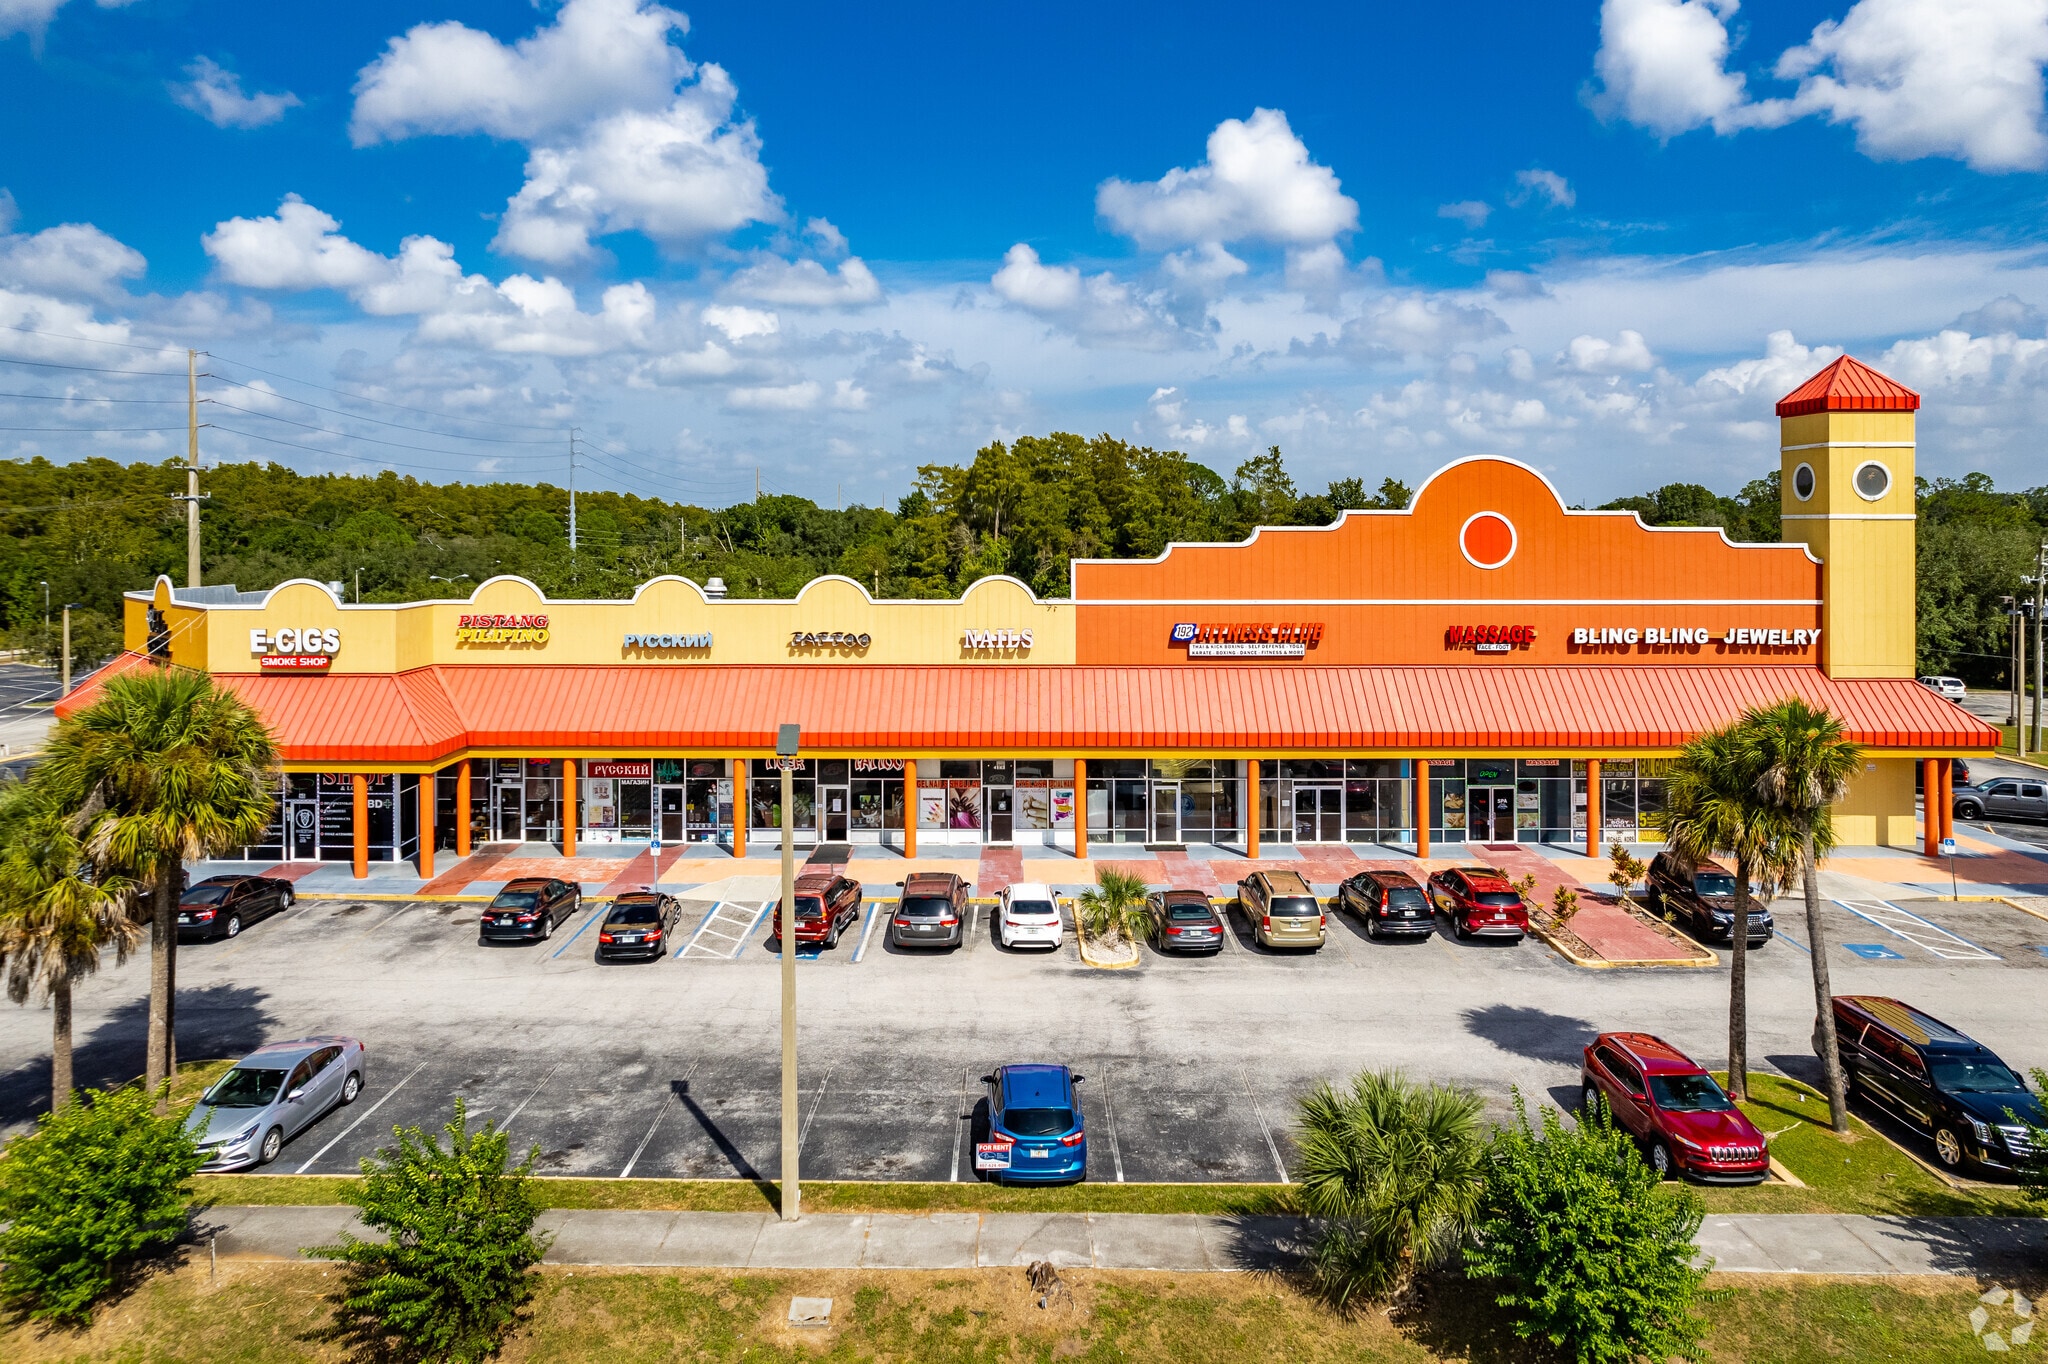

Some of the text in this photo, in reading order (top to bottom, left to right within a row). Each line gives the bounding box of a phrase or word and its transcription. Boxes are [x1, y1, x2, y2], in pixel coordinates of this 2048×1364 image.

[458, 614, 548, 628] PISTANG
[457, 628, 550, 643] PILIPINO
[964, 628, 1034, 649] NAILS
[1176, 626, 1192, 637] 192
[1198, 623, 1325, 641] FITNESS CLUB
[1449, 625, 1535, 643] MASSAGE
[1574, 628, 1821, 645] BLING BLING JEWELRY
[250, 628, 340, 653] E-CIGS
[624, 631, 713, 648] РУССКИЙ
[790, 632, 872, 648] TATTOO
[262, 658, 327, 666] SMOKE SHOP
[594, 764, 649, 777] РУССКИЙ
[1619, 764, 1634, 772] GOLD
[917, 780, 928, 788] GEL
